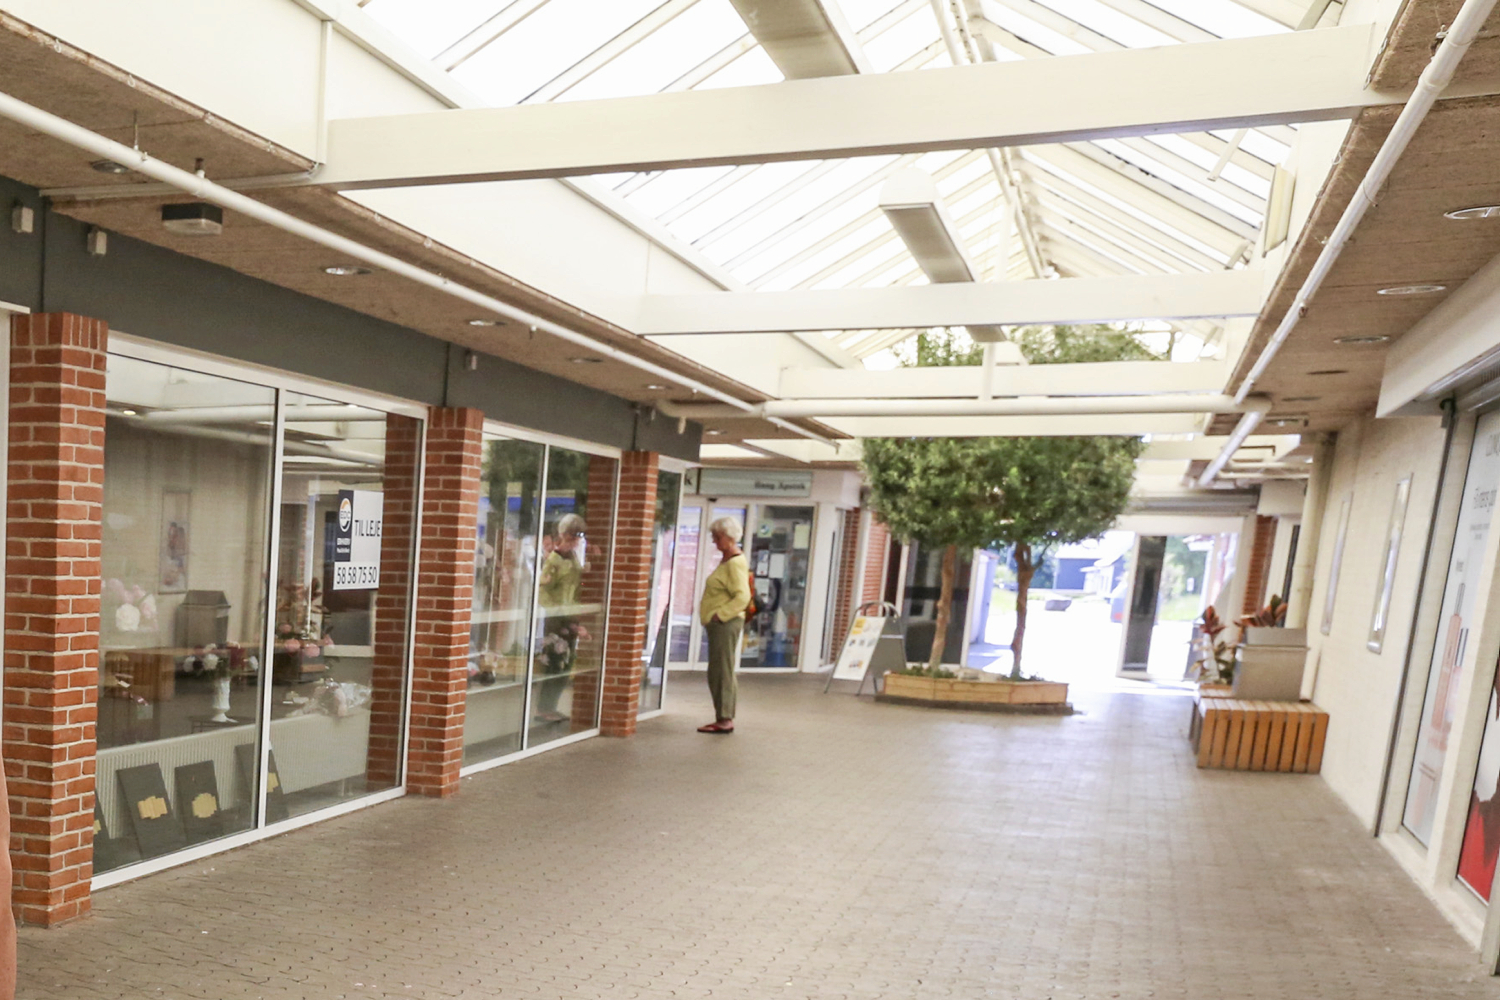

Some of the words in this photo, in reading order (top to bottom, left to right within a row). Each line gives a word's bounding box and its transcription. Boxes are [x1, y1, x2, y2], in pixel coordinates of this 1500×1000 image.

[336, 566, 346, 584] 58
[347, 566, 357, 584] 58
[358, 566, 367, 583] 75
[368, 566, 377, 583] 50
